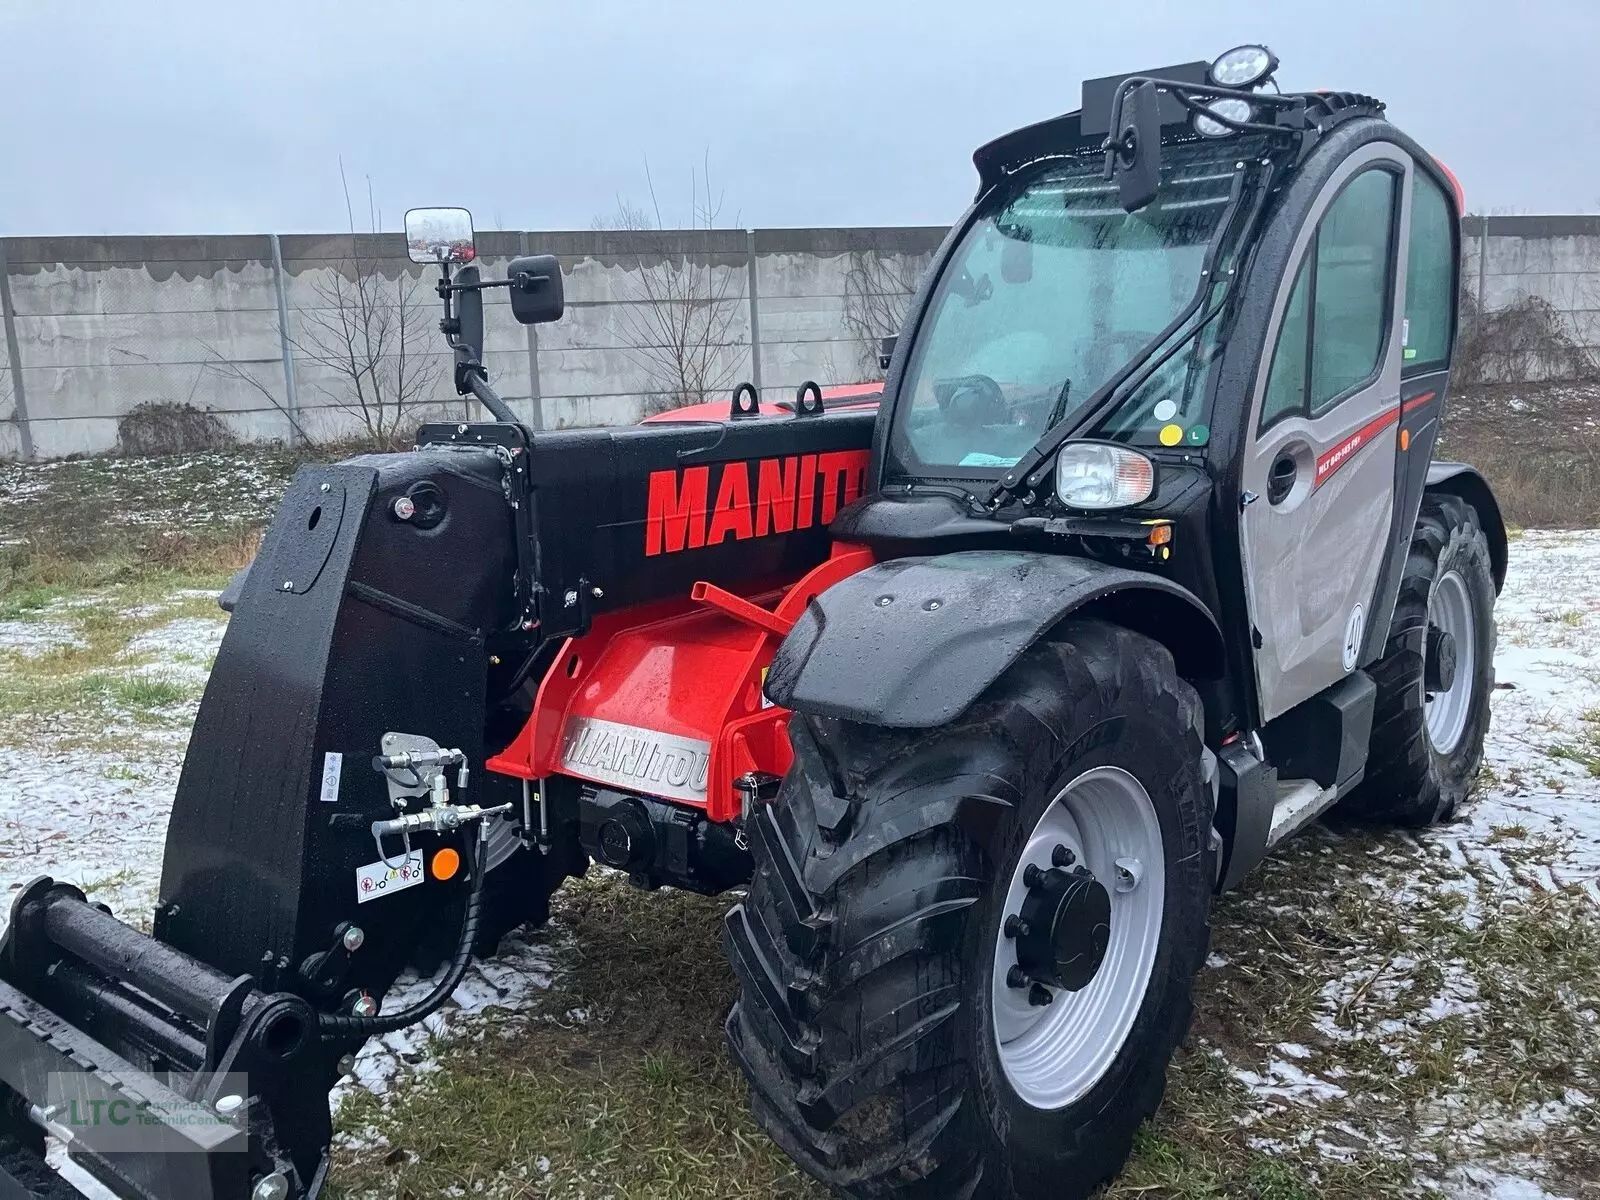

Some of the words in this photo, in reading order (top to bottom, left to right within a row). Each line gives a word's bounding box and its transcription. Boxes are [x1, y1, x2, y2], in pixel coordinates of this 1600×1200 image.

[1192, 432, 1199, 440] L
[646, 449, 869, 557] MANIT
[1347, 615, 1361, 659] 40
